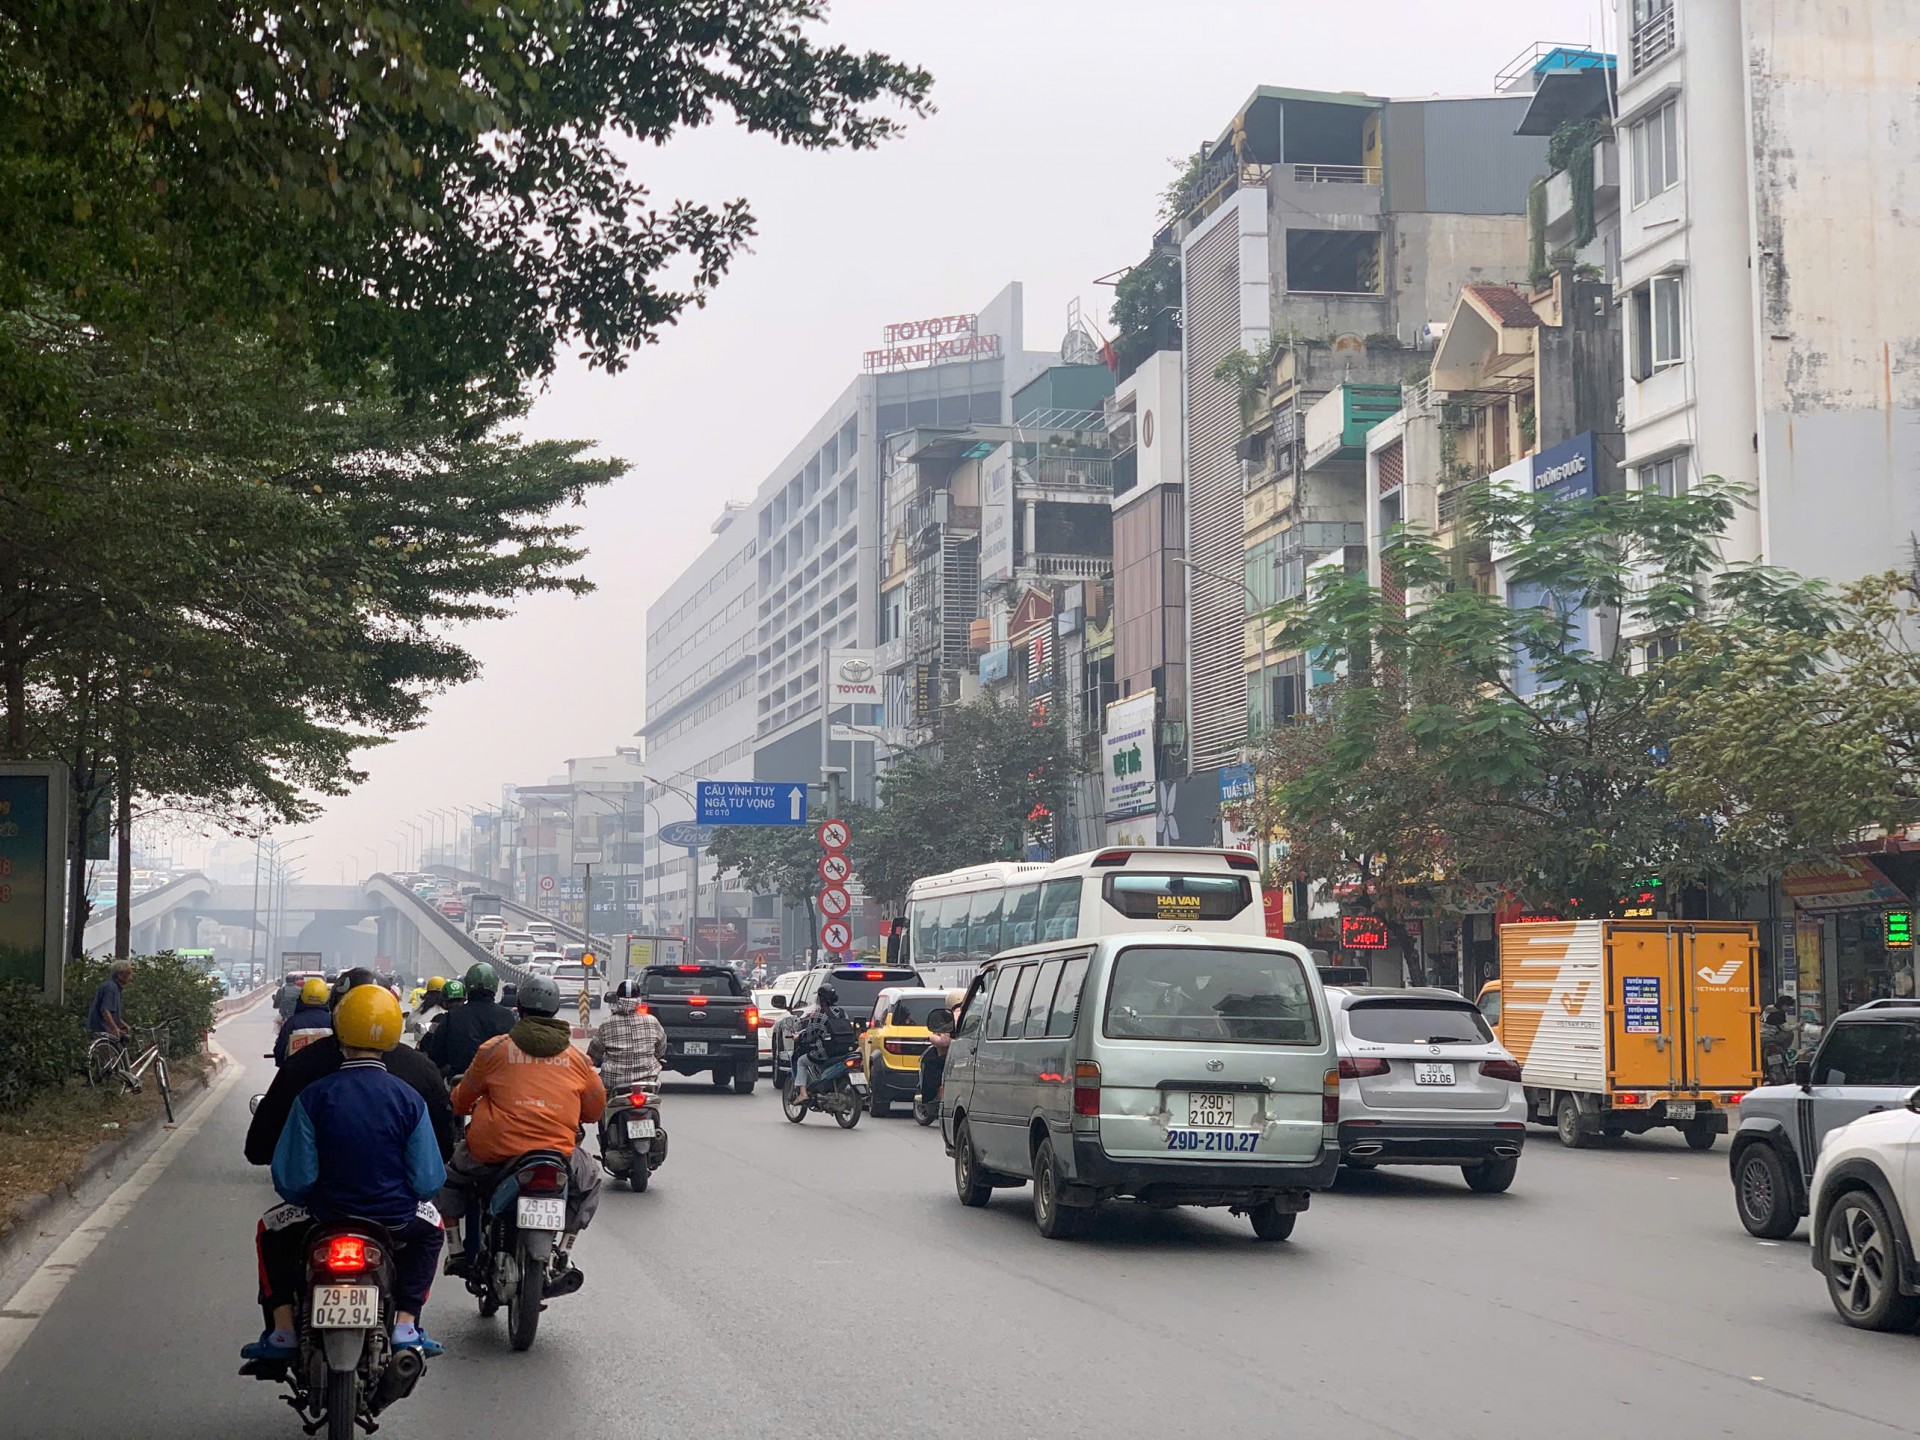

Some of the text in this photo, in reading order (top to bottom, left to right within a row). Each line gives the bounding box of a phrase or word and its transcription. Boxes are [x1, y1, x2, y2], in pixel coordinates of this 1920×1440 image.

[887, 314, 970, 342] TOYOTA
[867, 344, 932, 367] THANH
[836, 685, 876, 695] TOYOTA
[704, 784, 776, 796] CẦU VĨNH TUY
[746, 798, 776, 810] VỌNG
[671, 823, 713, 843] Ford
[1157, 896, 1200, 906] HAI VAN
[1426, 1064, 1444, 1074] 30K
[1420, 1074, 1452, 1084] 632.06
[1200, 1094, 1224, 1109] 29D
[1190, 1110, 1232, 1125] 210.27
[1168, 1130, 1260, 1152] 29D-210.27
[524, 1200, 558, 1213] 29-L5
[520, 1214, 562, 1228] 002.03
[322, 1290, 368, 1306] 29-BN
[316, 1308, 372, 1325] 042.94
